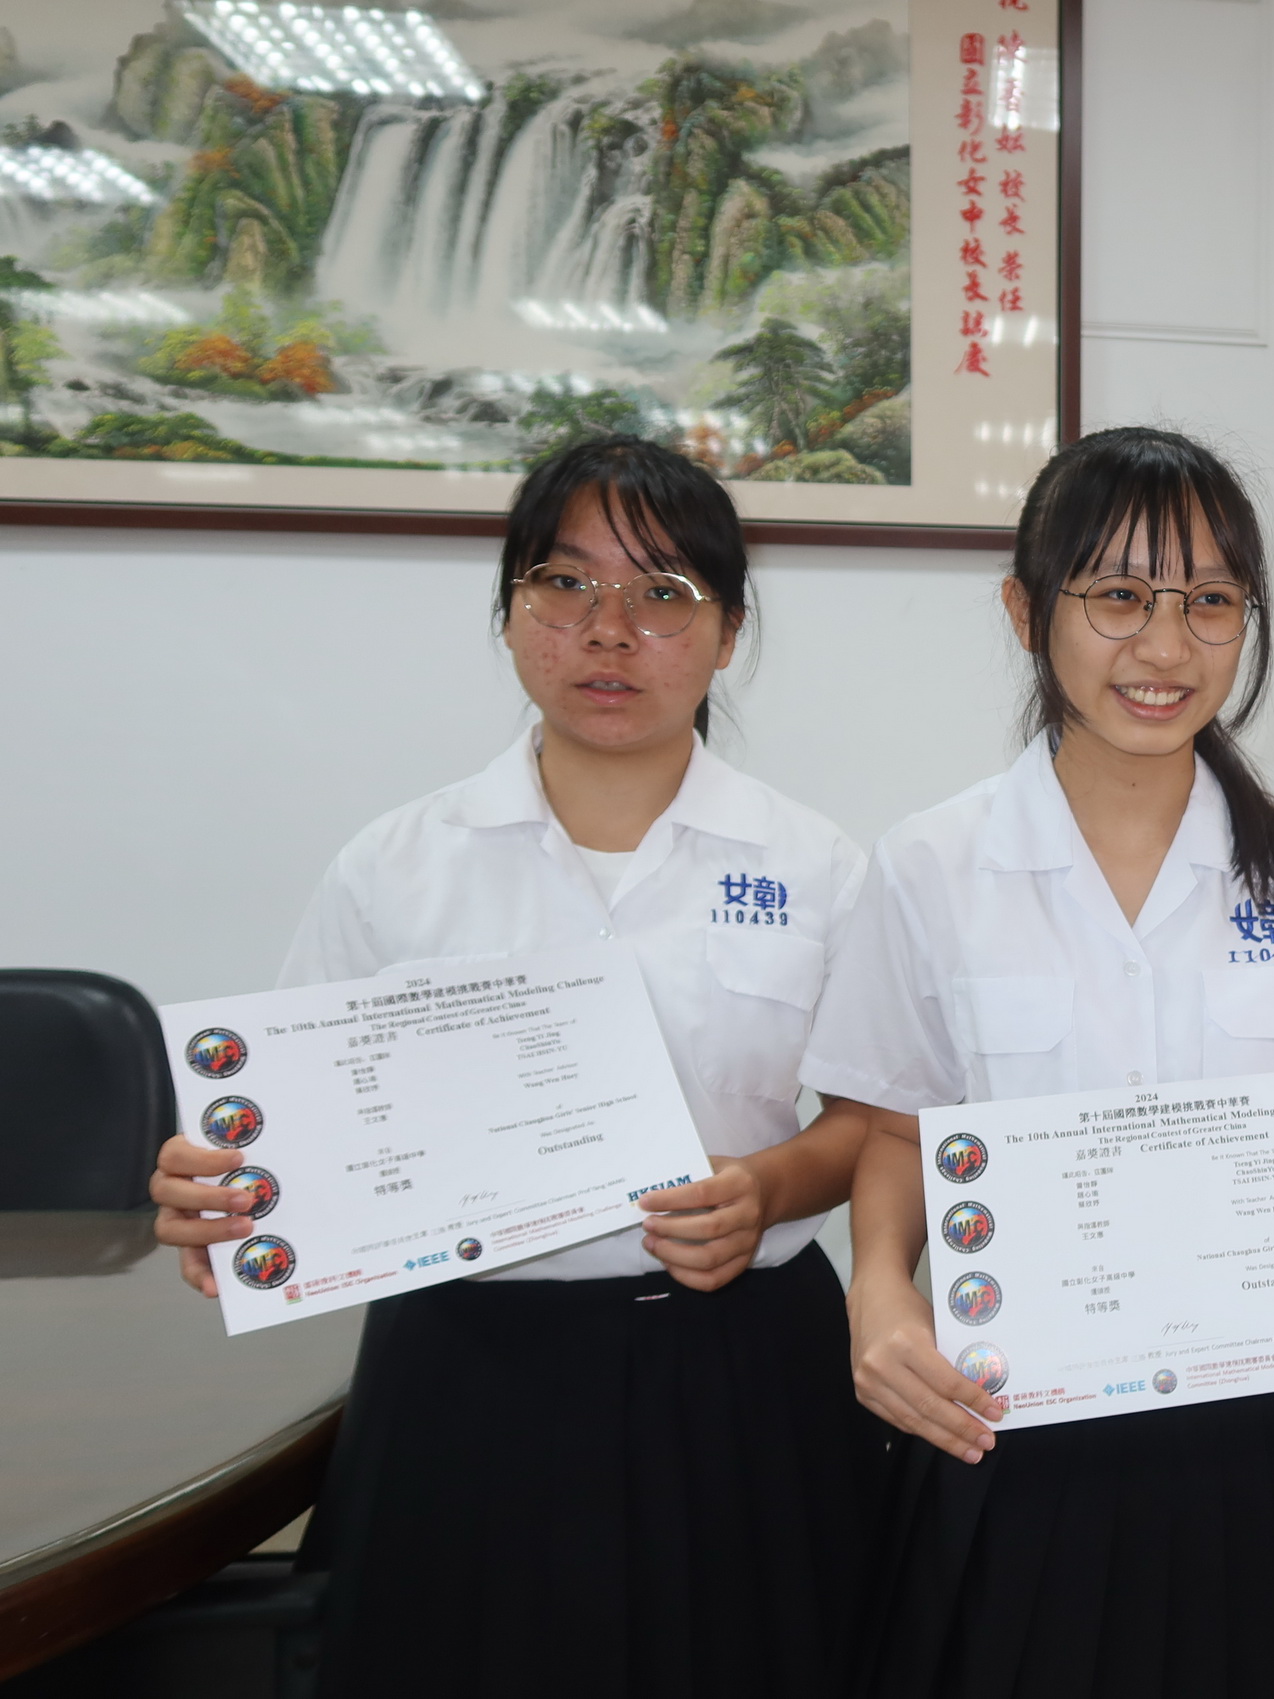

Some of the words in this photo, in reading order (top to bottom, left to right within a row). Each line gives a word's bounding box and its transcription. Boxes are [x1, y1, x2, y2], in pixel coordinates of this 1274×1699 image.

[710, 908, 788, 926] 110439
[1134, 1092, 1158, 1102] 2024
[1004, 1134, 1024, 1144] The
[1027, 1131, 1050, 1142] 10th
[1051, 1126, 1088, 1139] Annual
[1091, 1119, 1155, 1134] International
[1160, 1111, 1226, 1126] Mathematical
[1097, 1136, 1114, 1145] The
[1115, 1131, 1150, 1144] Regional
[1151, 1128, 1181, 1139] Contest
[1192, 1123, 1222, 1134] Greater
[1223, 1120, 1246, 1130] China
[1140, 1138, 1192, 1153] Certificate
[1207, 1129, 1269, 1145] Achievement
[416, 1250, 450, 1268] IEEE
[1115, 1379, 1146, 1393] IEEE
